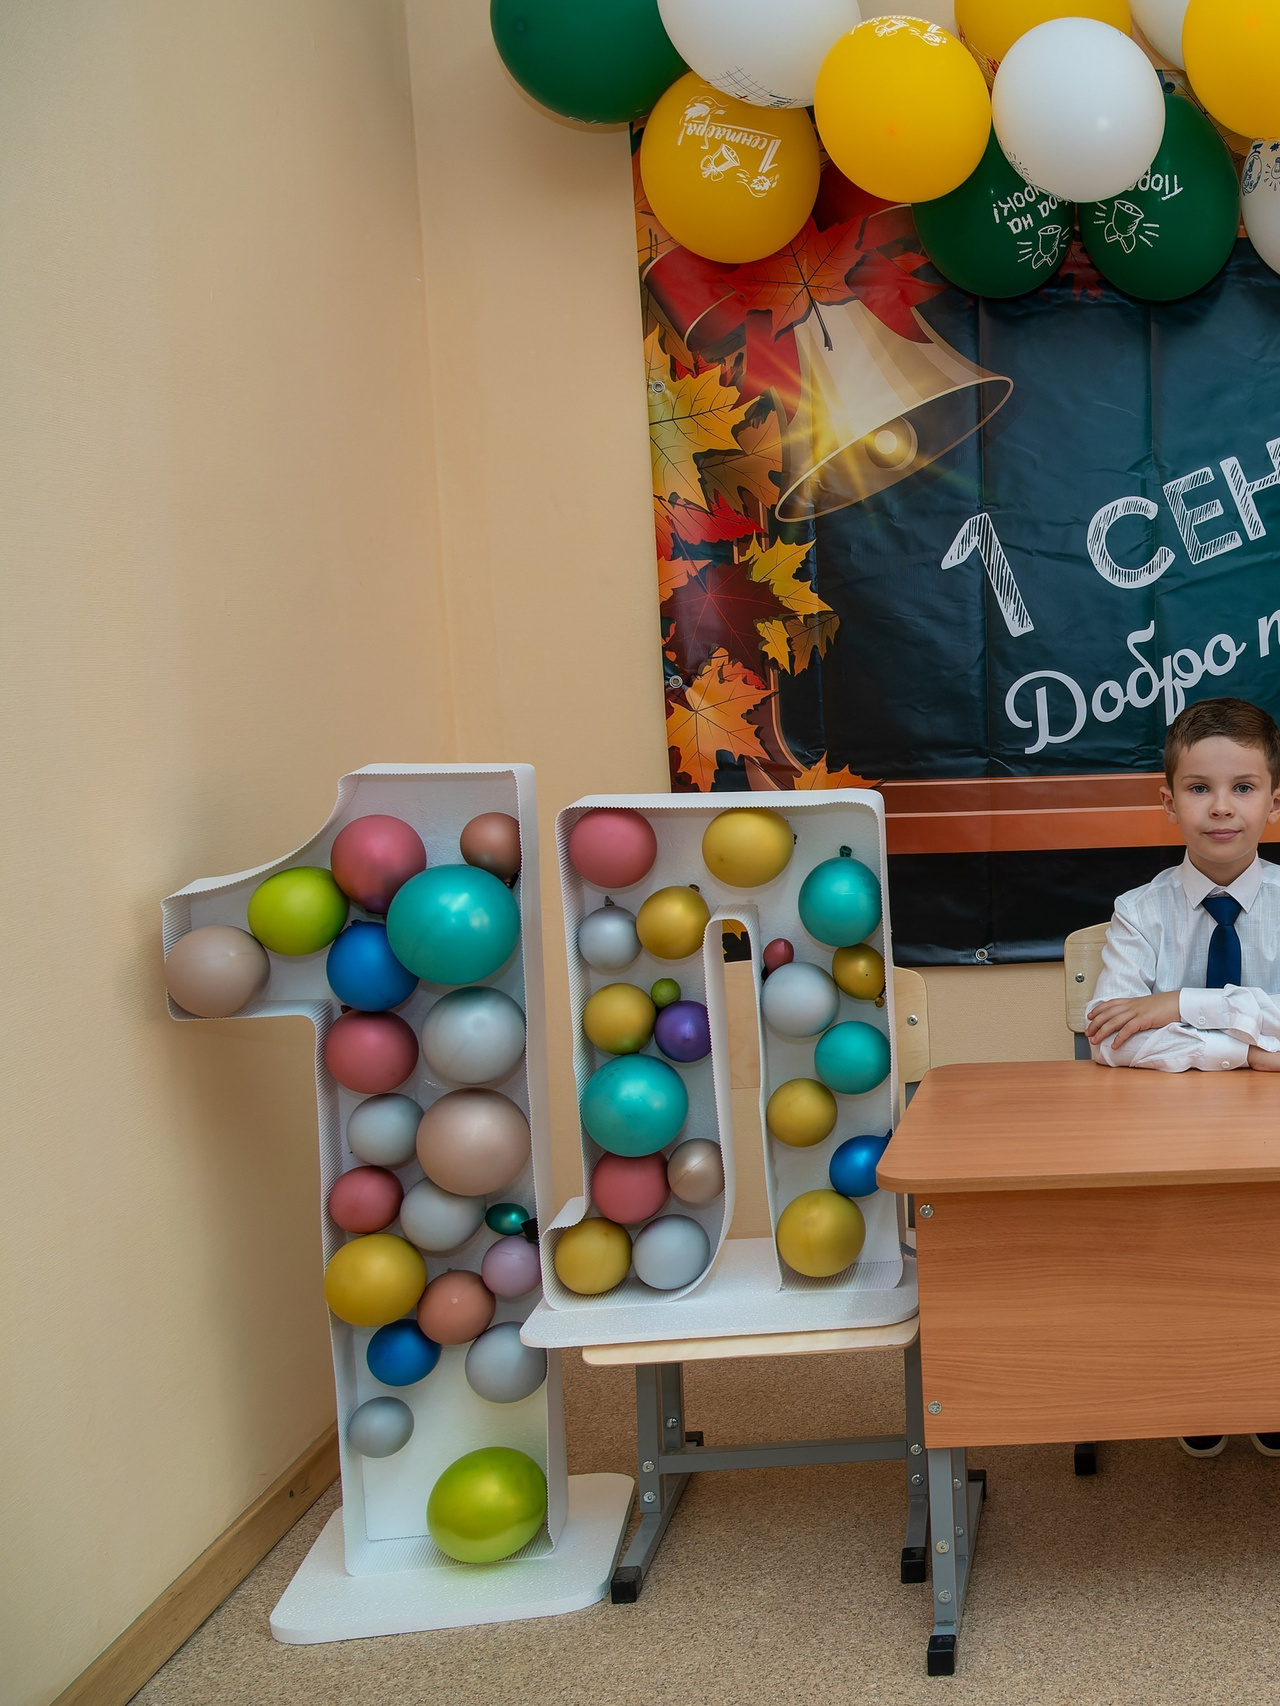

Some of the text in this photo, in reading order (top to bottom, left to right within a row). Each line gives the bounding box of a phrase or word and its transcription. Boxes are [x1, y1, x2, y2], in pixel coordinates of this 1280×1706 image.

[677, 114, 769, 150] сентября!
[1006, 213, 1034, 235] на
[941, 512, 1035, 638] 1
[1004, 620, 1247, 754] Добро
